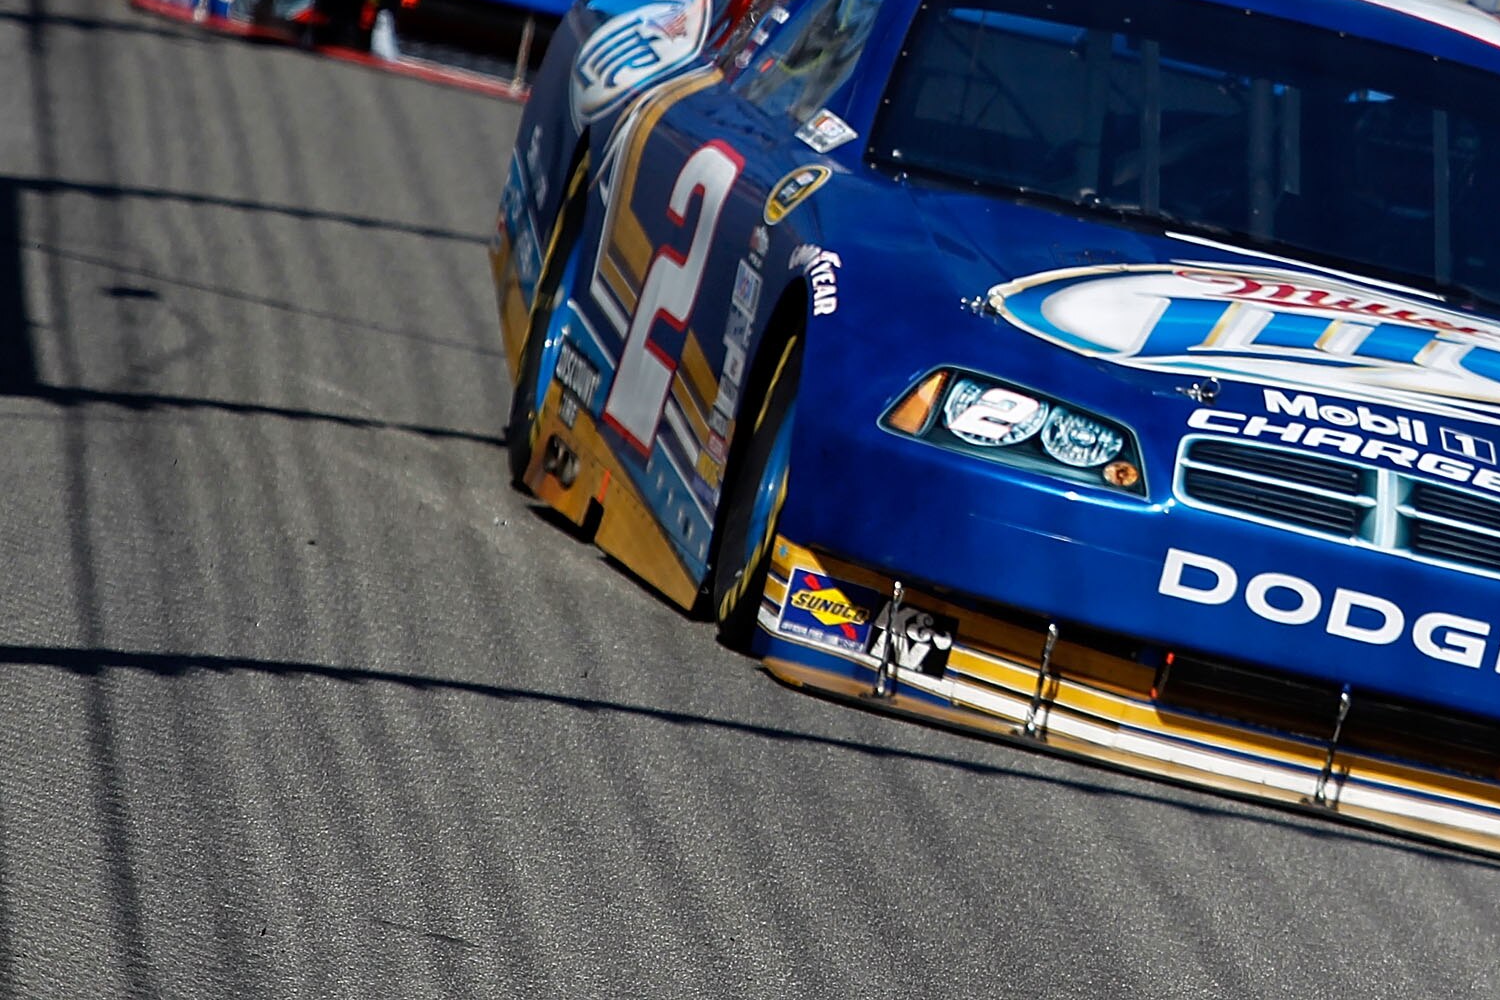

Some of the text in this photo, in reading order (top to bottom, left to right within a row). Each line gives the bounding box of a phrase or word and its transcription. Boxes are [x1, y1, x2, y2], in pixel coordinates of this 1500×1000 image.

[602, 139, 746, 457] 2
[949, 388, 1040, 440] 2
[1263, 389, 1429, 446] Mobil
[798, 592, 869, 623] SUNOCO
